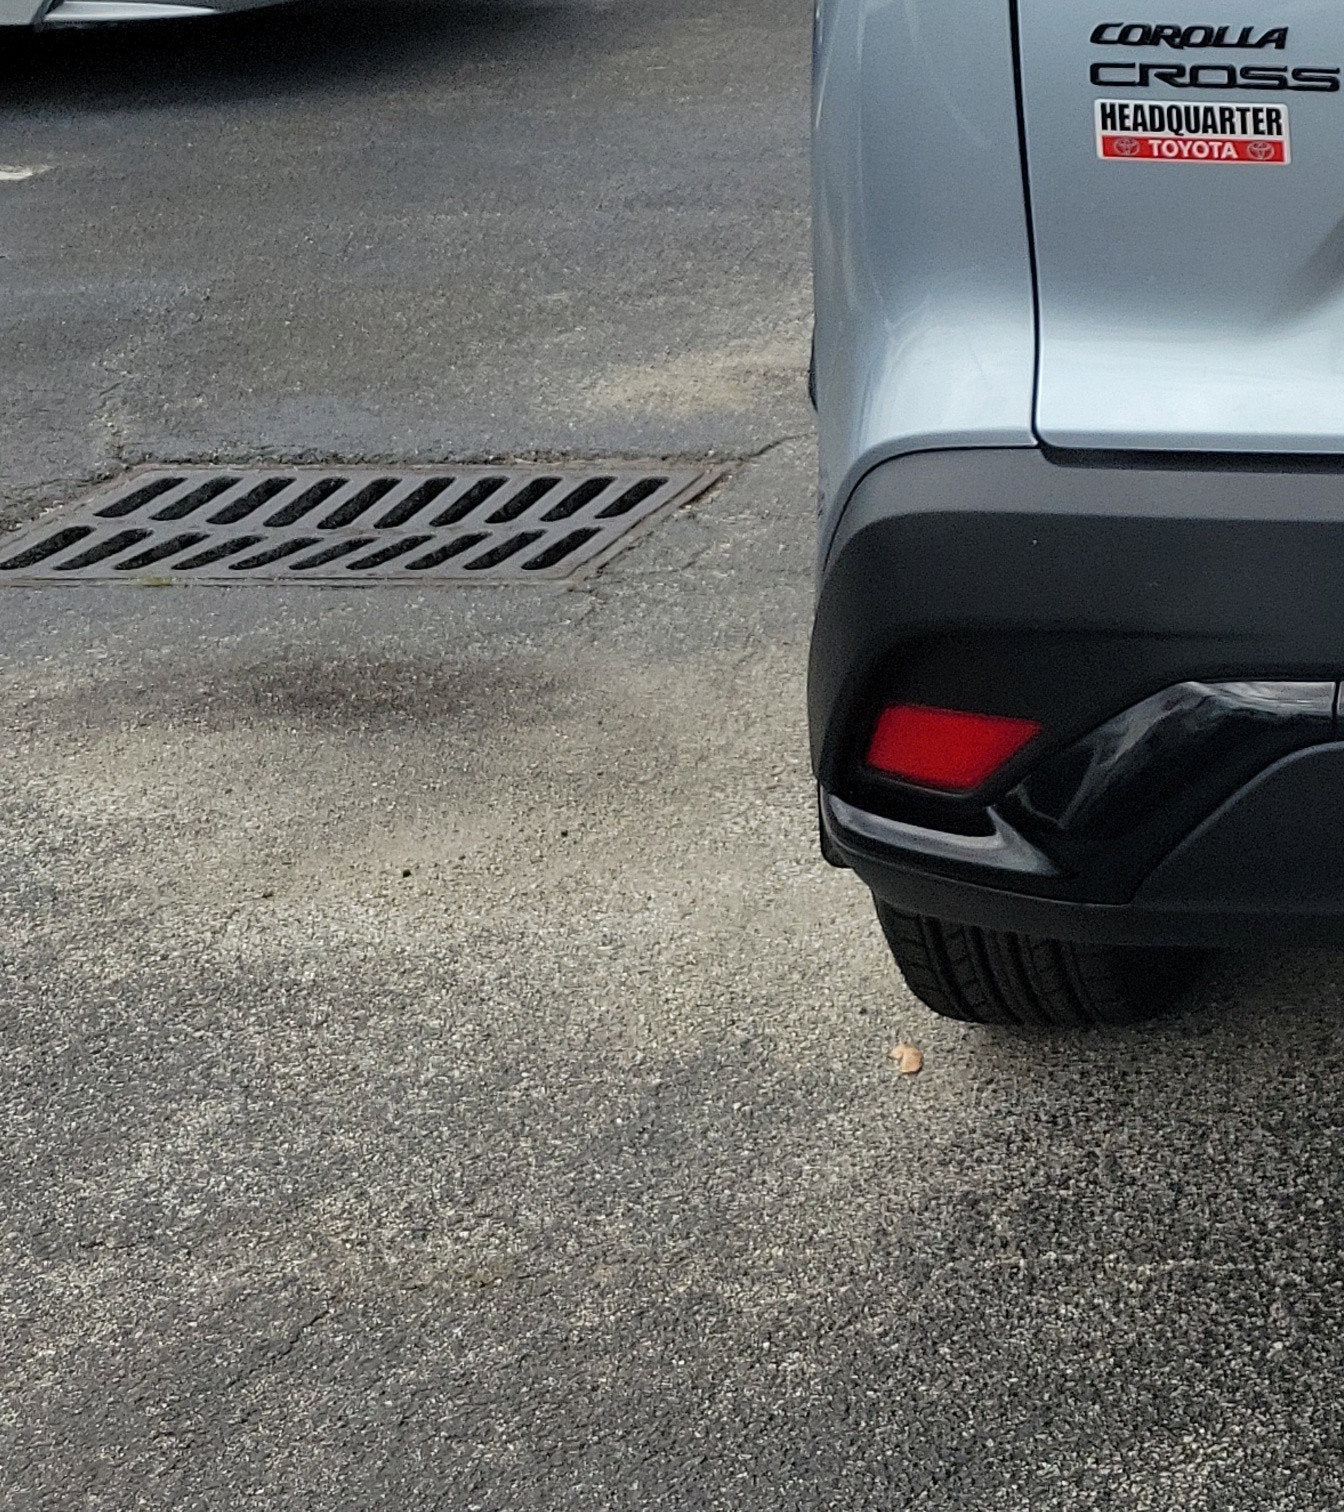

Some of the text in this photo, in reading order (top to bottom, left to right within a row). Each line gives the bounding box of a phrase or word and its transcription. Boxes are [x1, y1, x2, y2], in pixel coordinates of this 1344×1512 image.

[1090, 22, 1289, 50] COROLLA
[1090, 61, 1340, 92] CROSS
[1100, 103, 1283, 136] HEADQUARTER
[1148, 139, 1239, 159] TOYOTA
